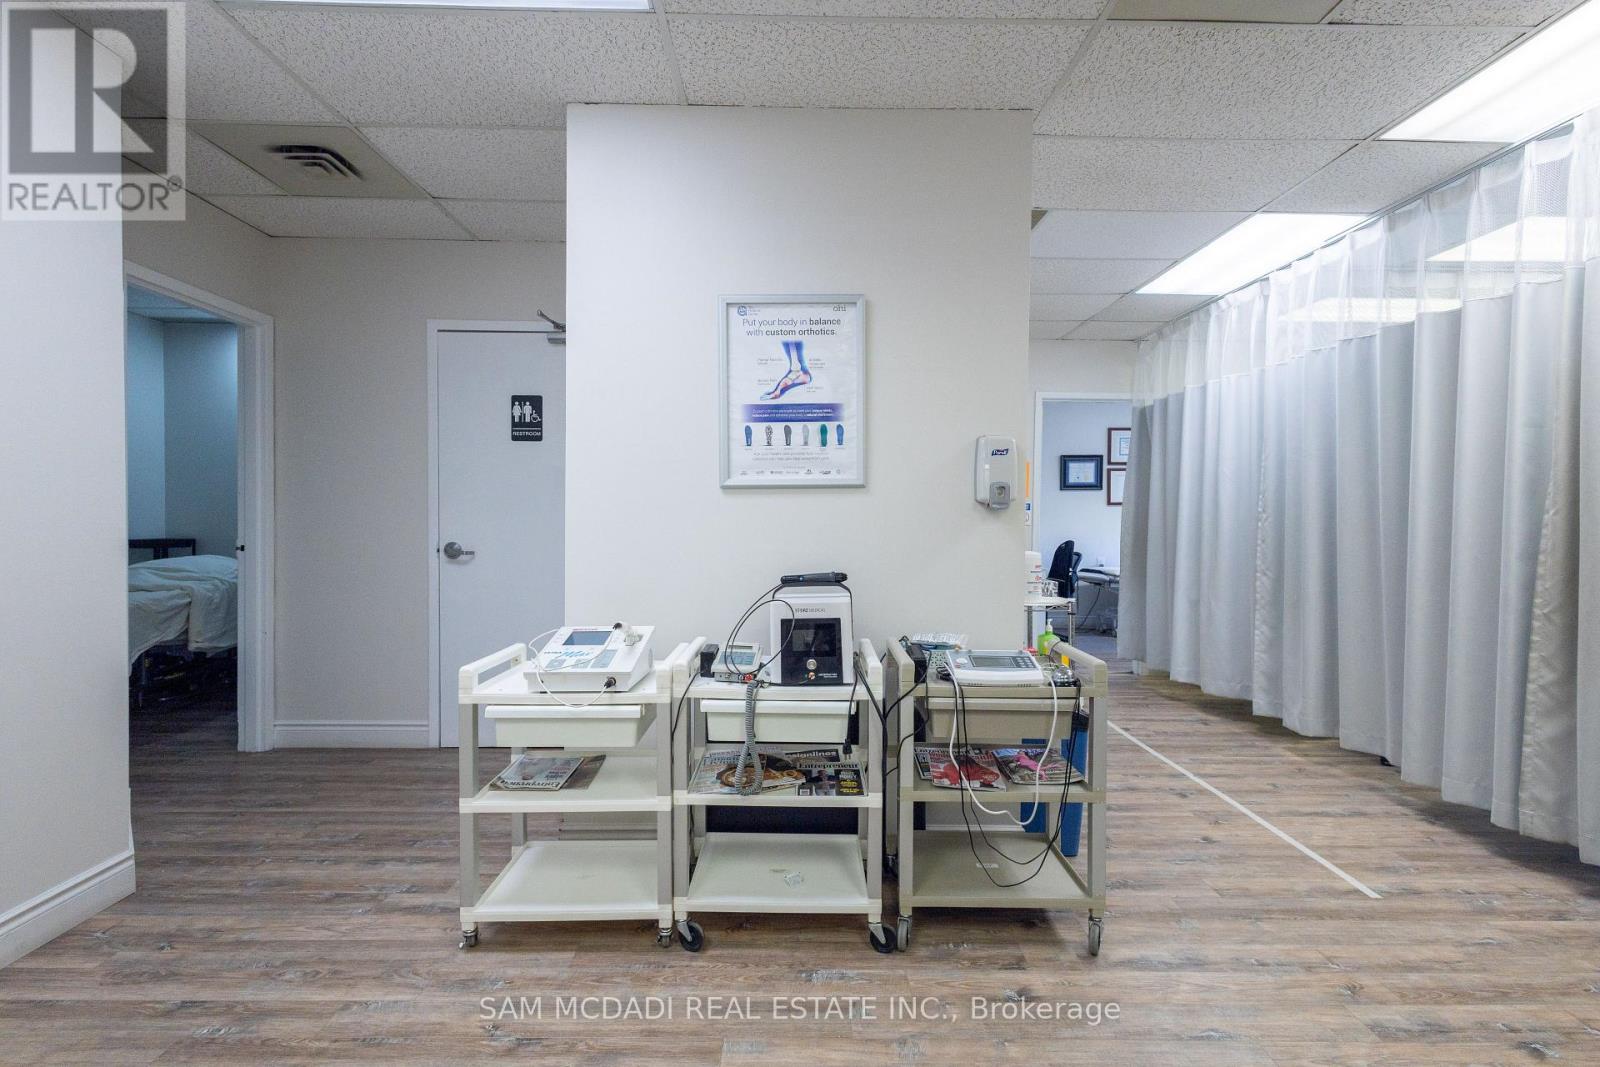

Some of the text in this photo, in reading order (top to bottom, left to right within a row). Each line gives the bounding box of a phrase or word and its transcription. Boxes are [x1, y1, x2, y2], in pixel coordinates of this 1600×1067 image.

[742, 317, 841, 328] Put your body in balance
[746, 328, 763, 337] with
